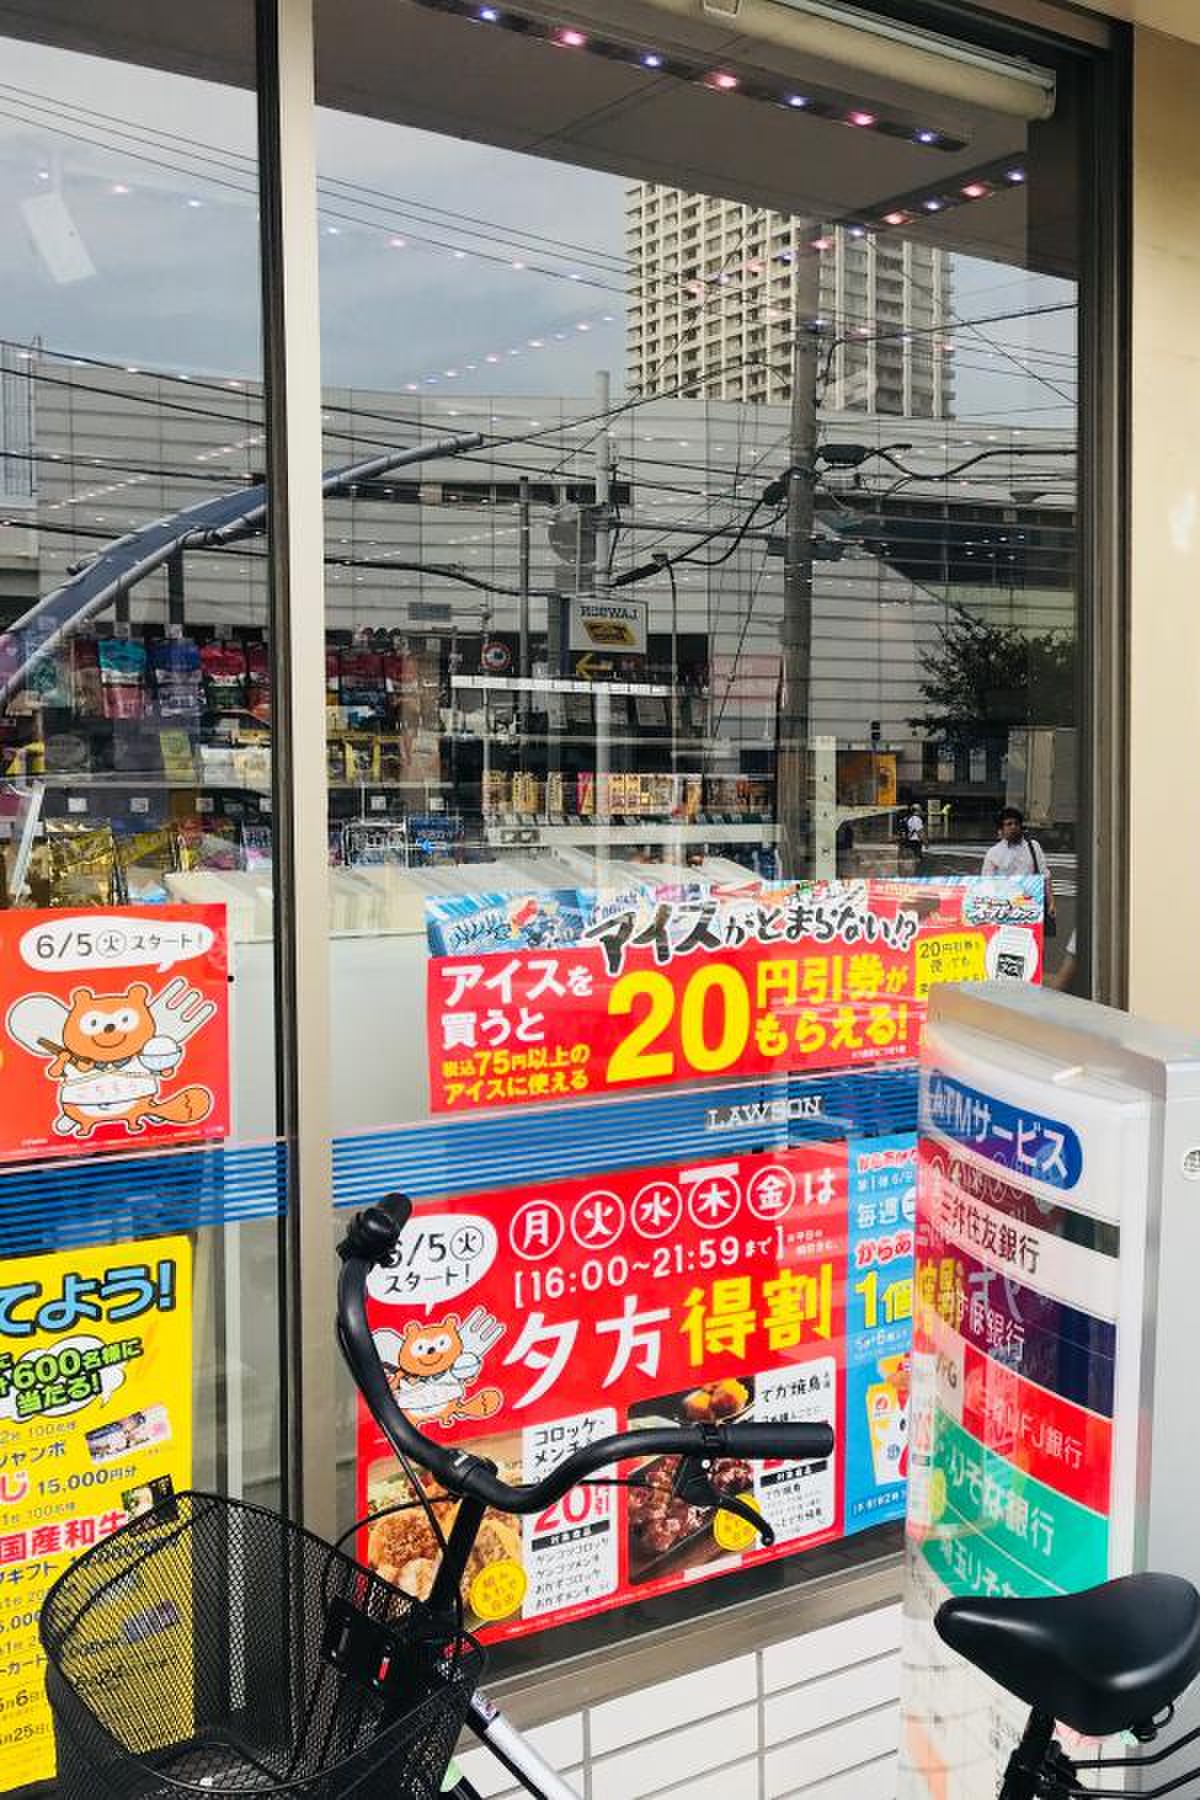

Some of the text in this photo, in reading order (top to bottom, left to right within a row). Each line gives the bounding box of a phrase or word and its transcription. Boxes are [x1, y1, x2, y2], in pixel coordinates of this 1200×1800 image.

[441, 958, 593, 1007] アイスを
[757, 952, 909, 1009] 円引券が
[441, 1007, 545, 1050] 買うと
[606, 962, 750, 1084] 20
[755, 1002, 908, 1057] もらえる!
[445, 1069, 589, 1105] アイスに使える
[706, 1095, 823, 1128] LAWSON
[502, 1263, 833, 1411] 夕方得割
